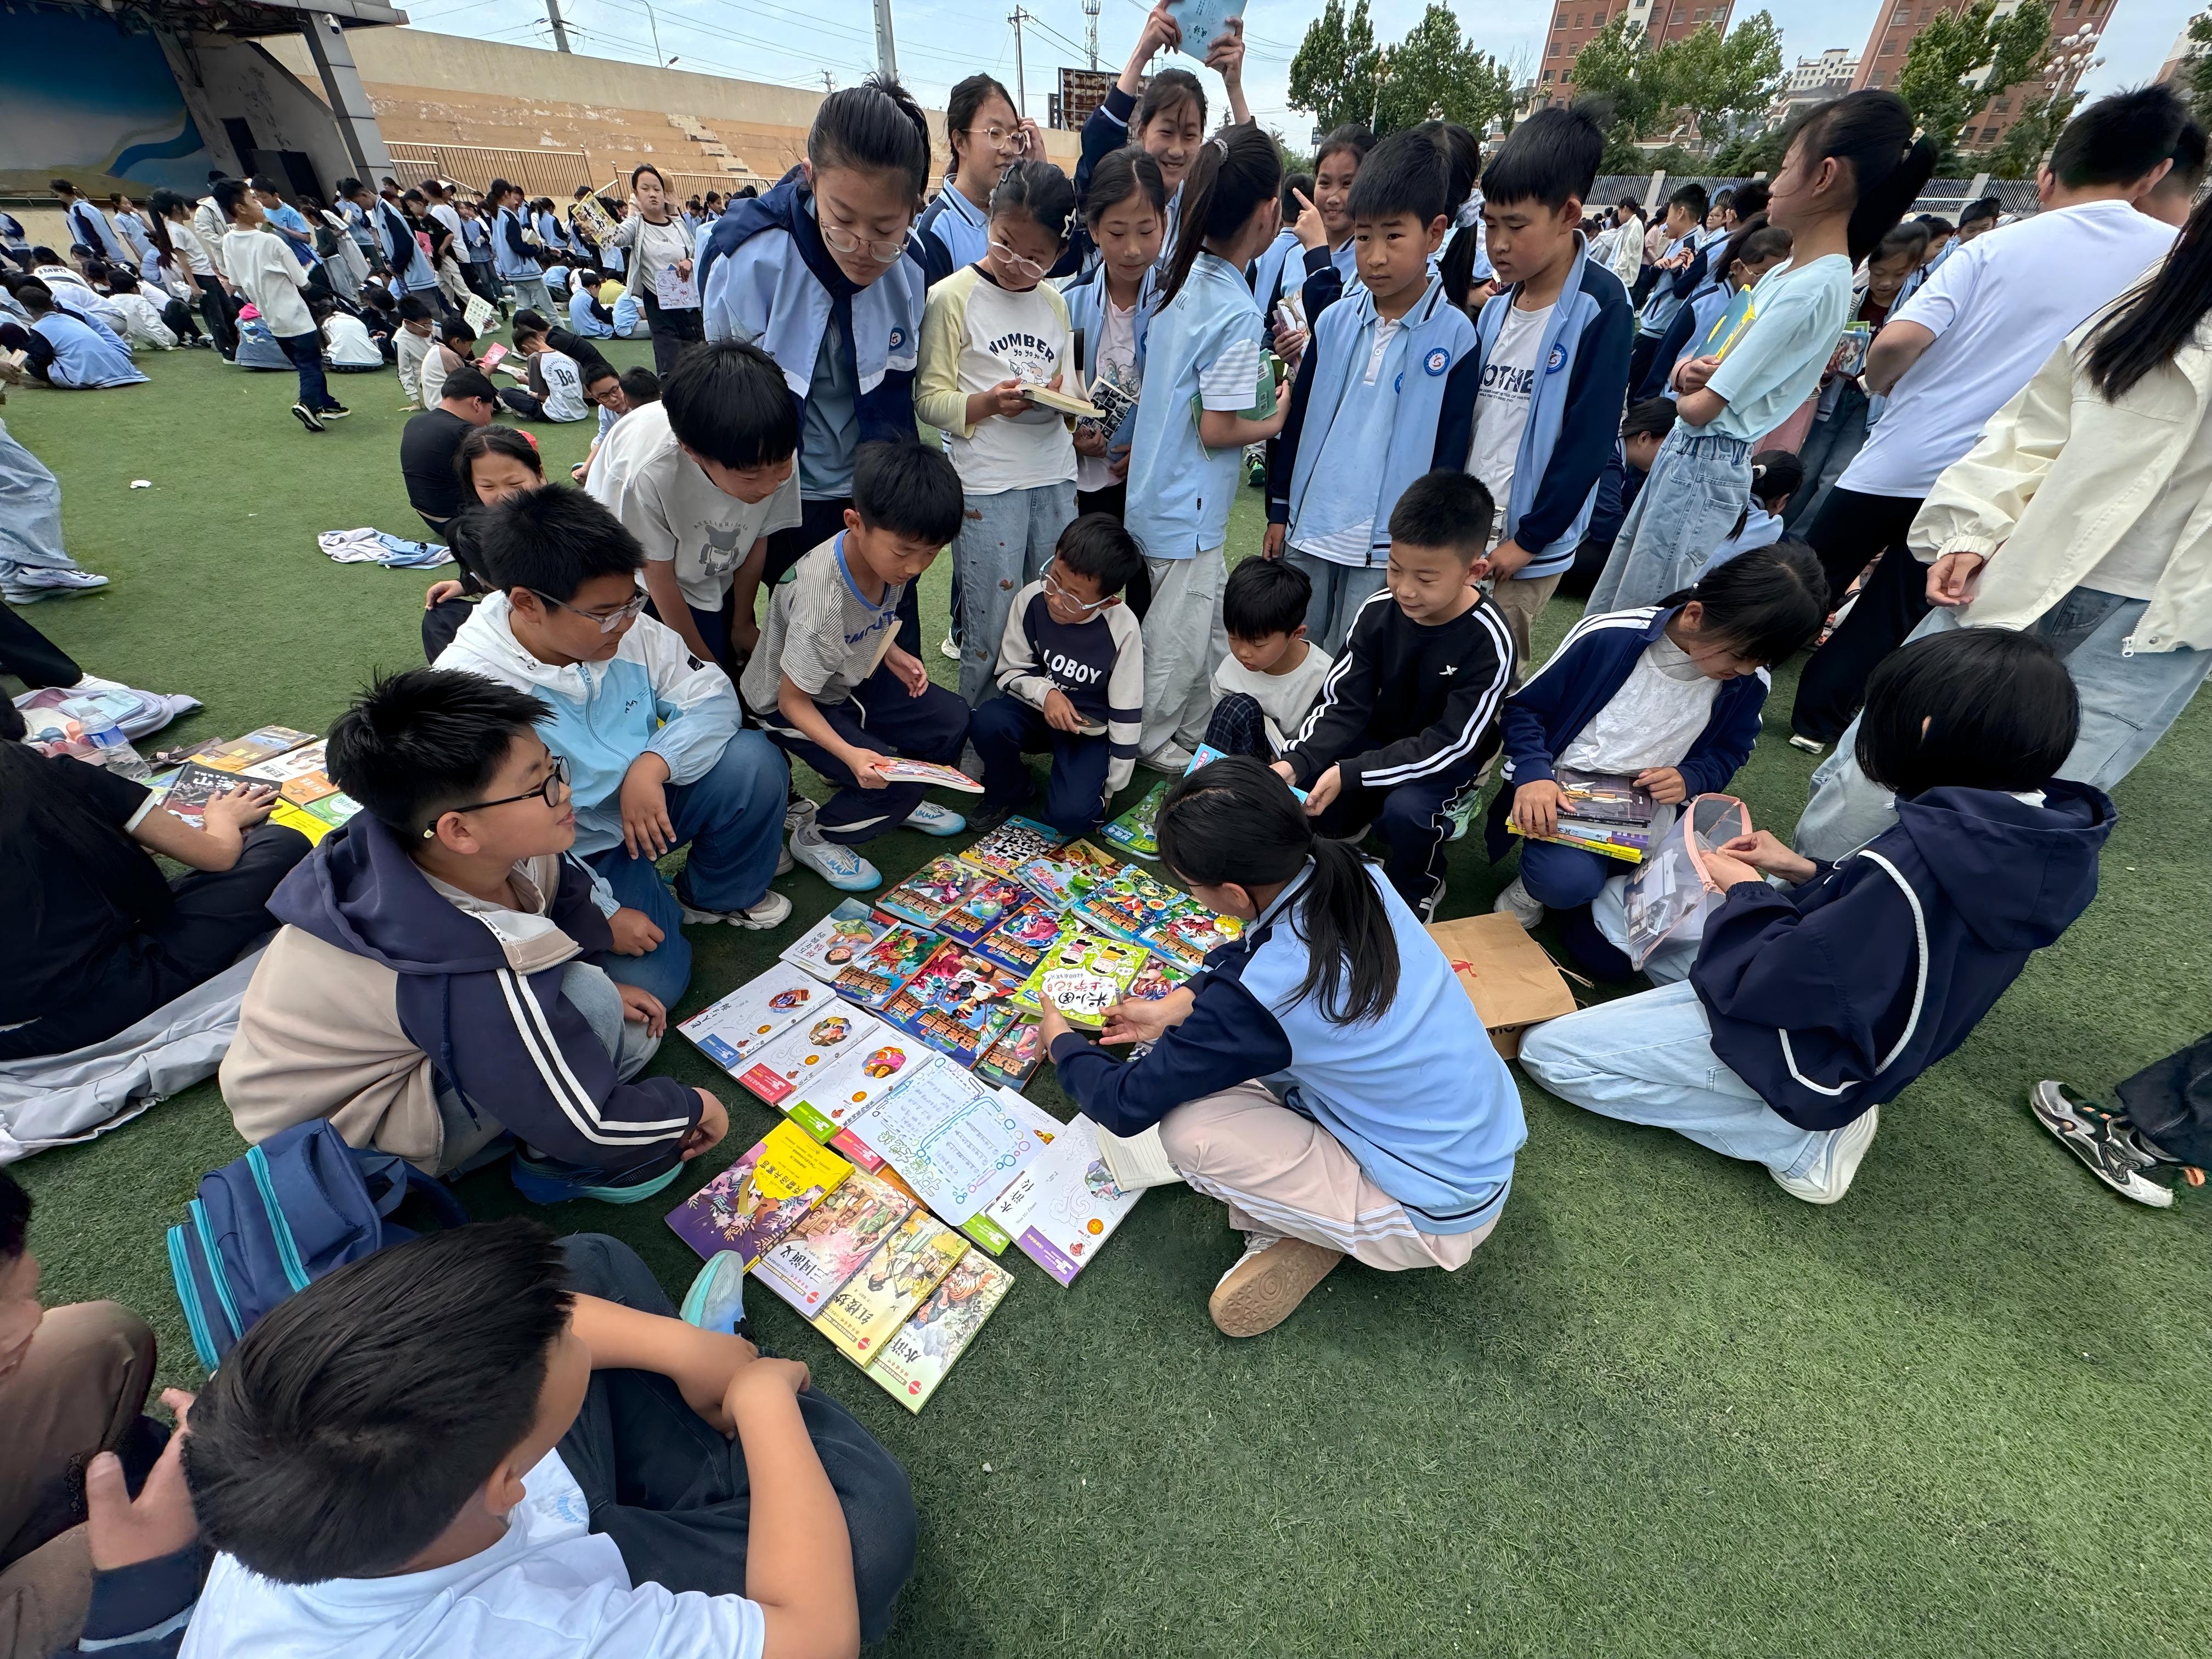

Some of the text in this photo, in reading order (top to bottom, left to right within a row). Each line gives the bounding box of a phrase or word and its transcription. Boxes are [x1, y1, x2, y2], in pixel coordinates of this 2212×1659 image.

[989, 332, 1054, 363] NUMBER
[1000, 1178, 1034, 1212] 水浒传
[779, 1245, 828, 1284] 三国演义
[832, 1293, 873, 1325] 红楼梦
[888, 1338, 921, 1363] 水浒
